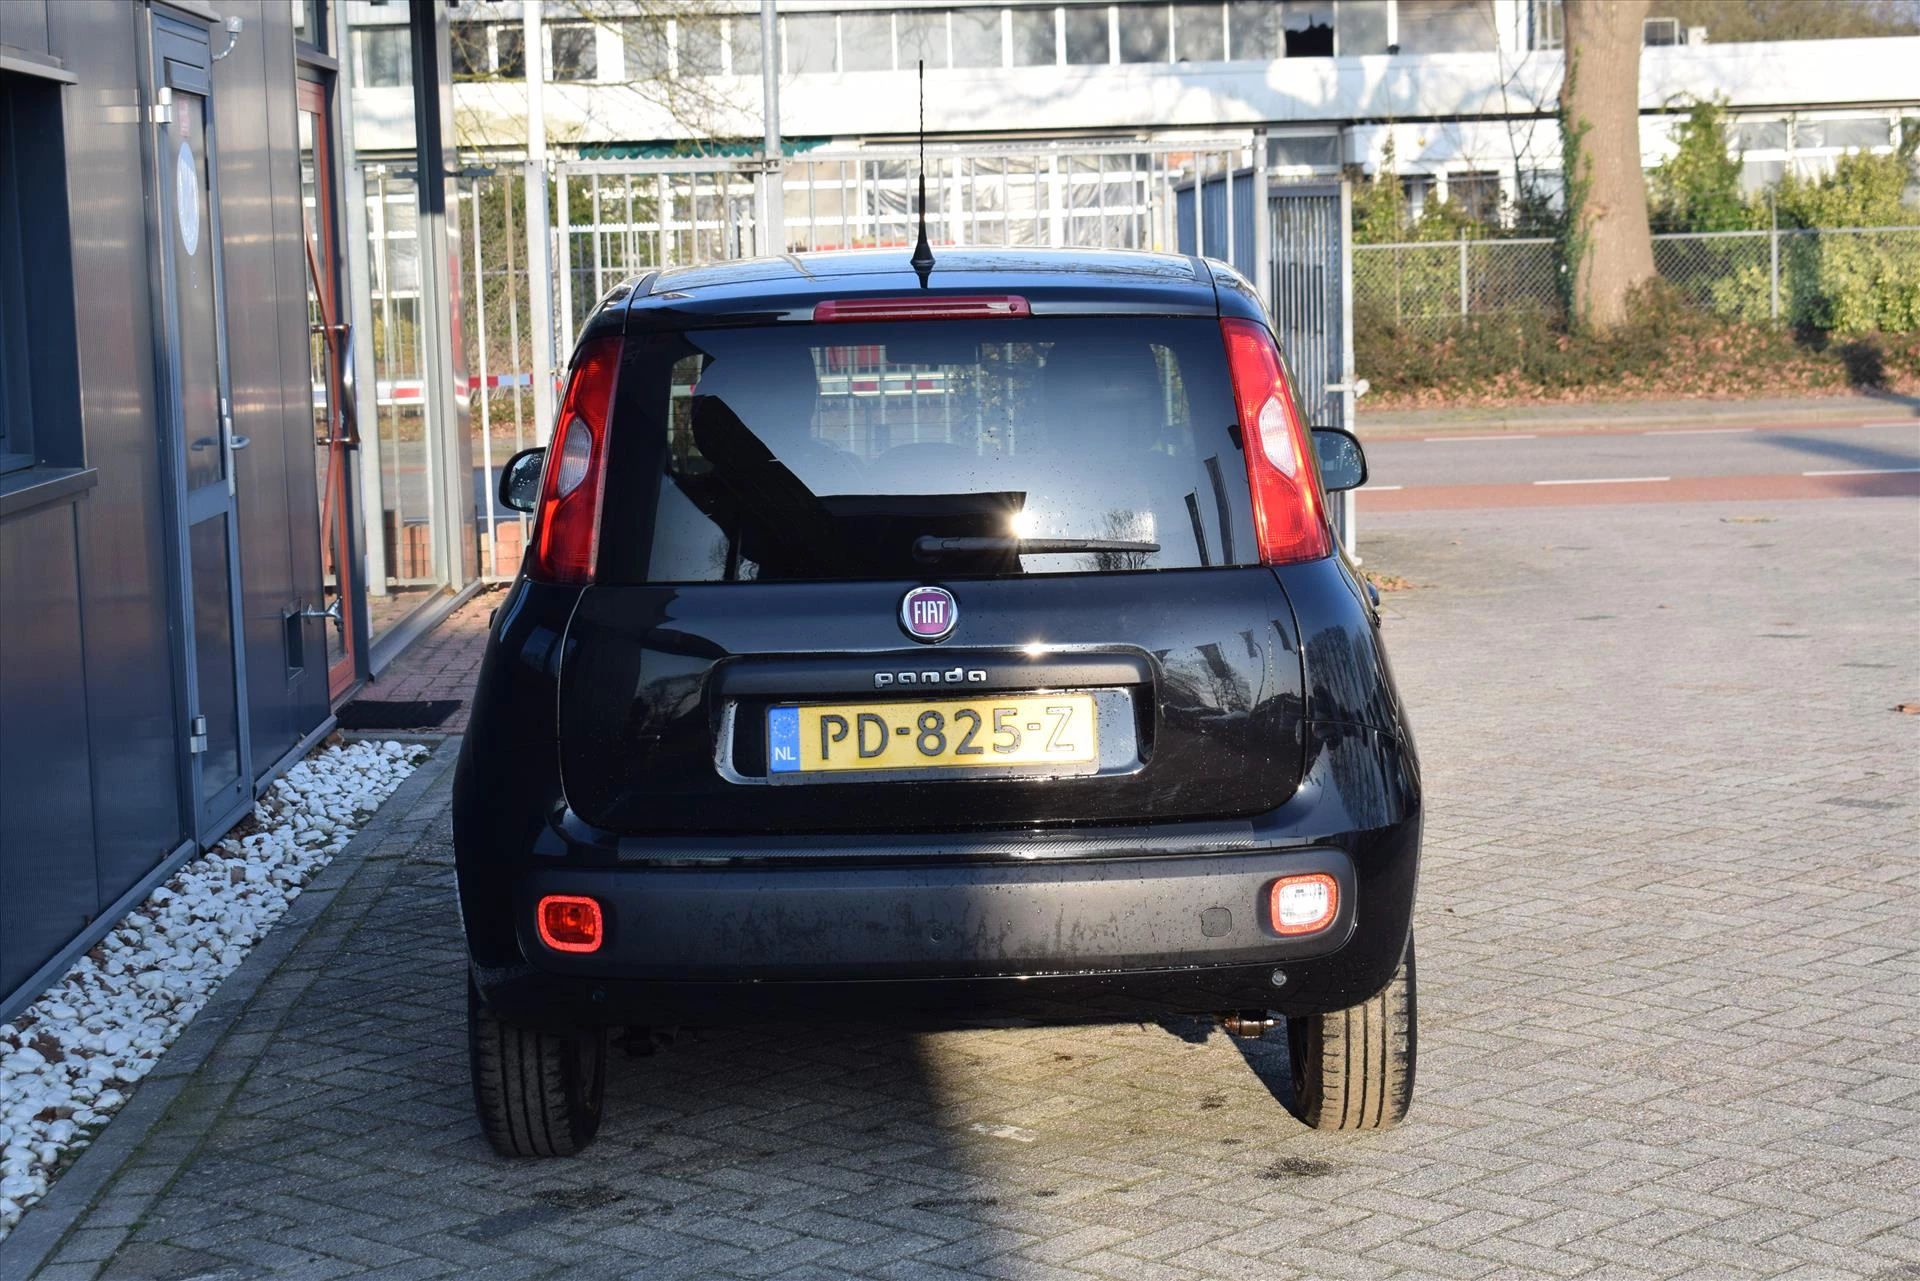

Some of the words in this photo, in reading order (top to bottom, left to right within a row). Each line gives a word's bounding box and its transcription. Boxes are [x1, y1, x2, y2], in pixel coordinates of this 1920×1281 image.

[913, 600, 946, 624] FIAT
[874, 668, 987, 688] panda
[821, 707, 1075, 760] PD-825-Z
[774, 746, 796, 761] NL
